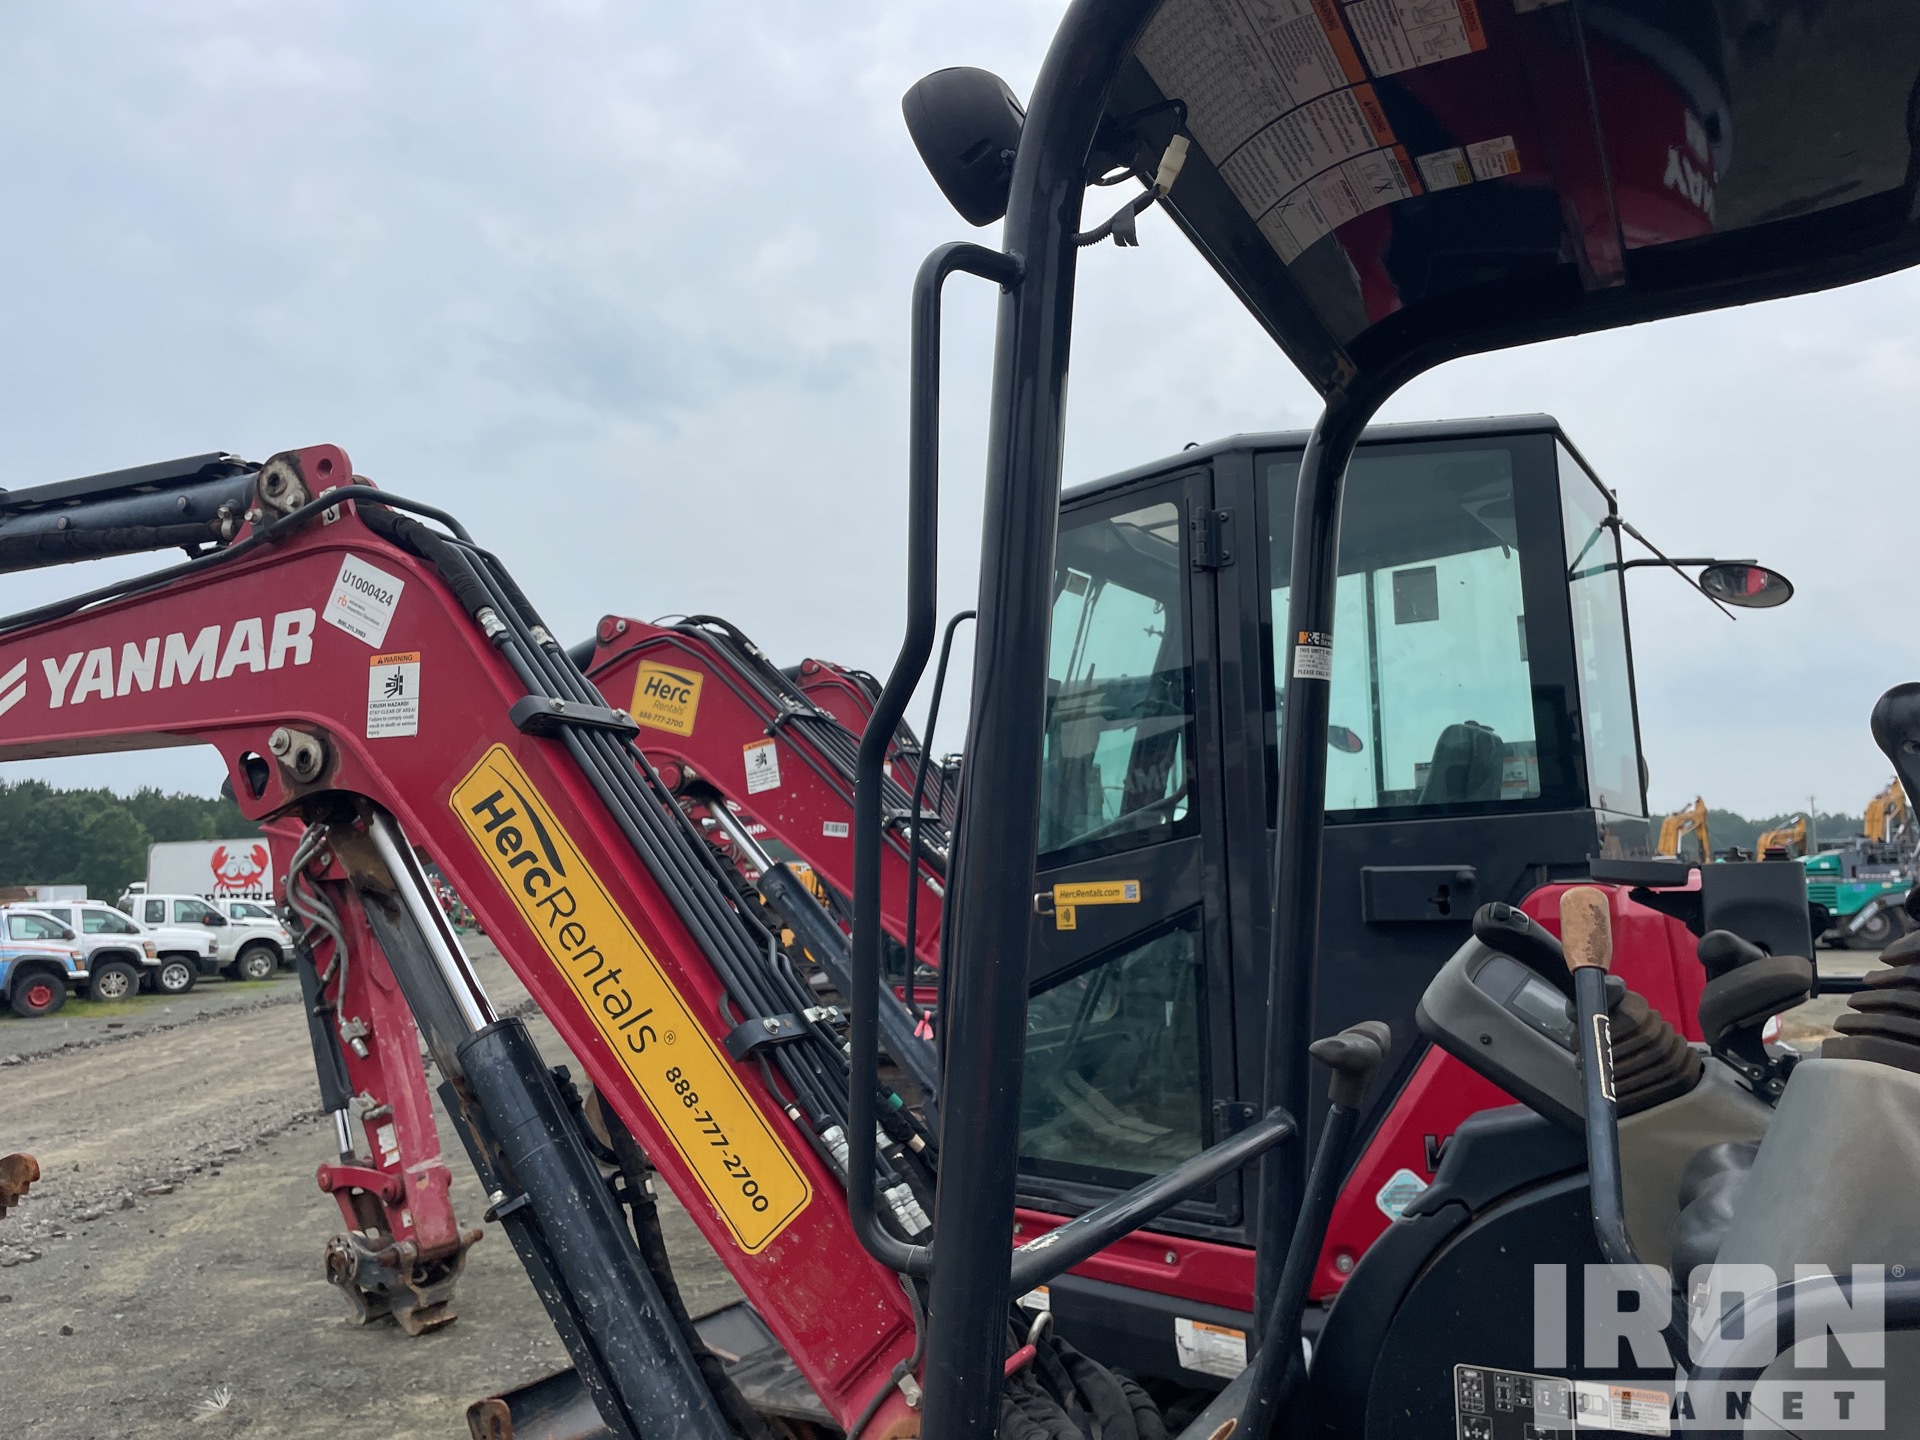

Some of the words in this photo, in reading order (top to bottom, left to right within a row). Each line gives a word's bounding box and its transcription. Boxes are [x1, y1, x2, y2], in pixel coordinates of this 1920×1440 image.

[342, 569, 394, 607] U1000424
[41, 607, 317, 710] YANMAR
[383, 654, 413, 664] WARNING
[644, 676, 691, 704] Herc
[653, 699, 684, 715] Rentals
[638, 711, 684, 729] 888-777-2700
[1059, 888, 1121, 899] HercRentals.com
[665, 1066, 769, 1213] 888-777-2700
